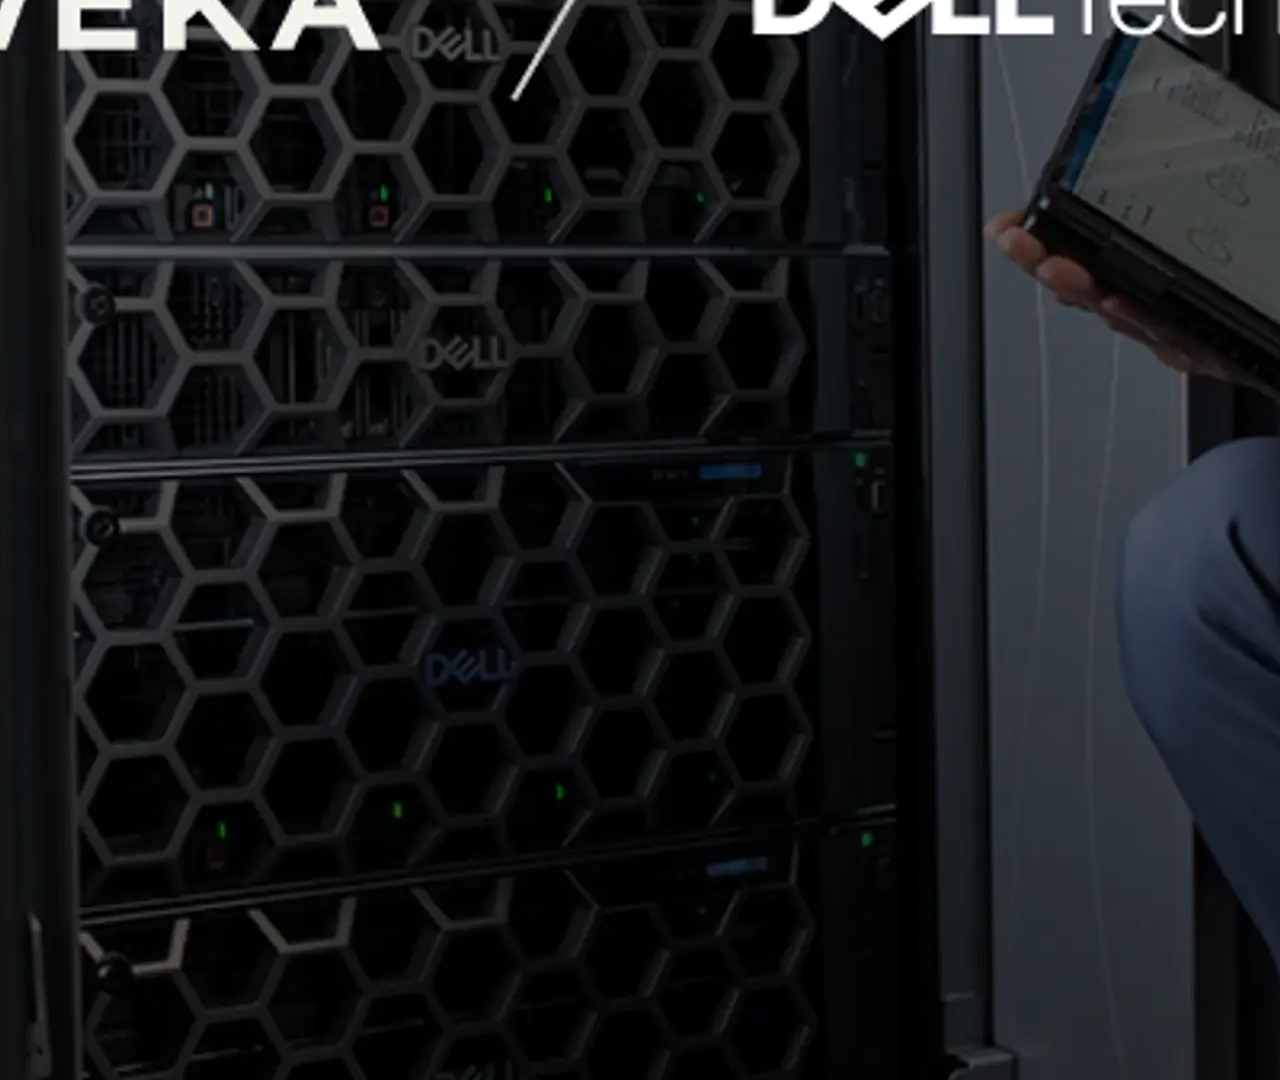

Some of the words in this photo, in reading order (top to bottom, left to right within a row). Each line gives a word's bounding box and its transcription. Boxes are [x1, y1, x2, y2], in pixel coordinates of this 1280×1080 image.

[412, 23, 502, 62] DELL
[420, 333, 513, 372] DELL
[424, 647, 517, 686] DELL
